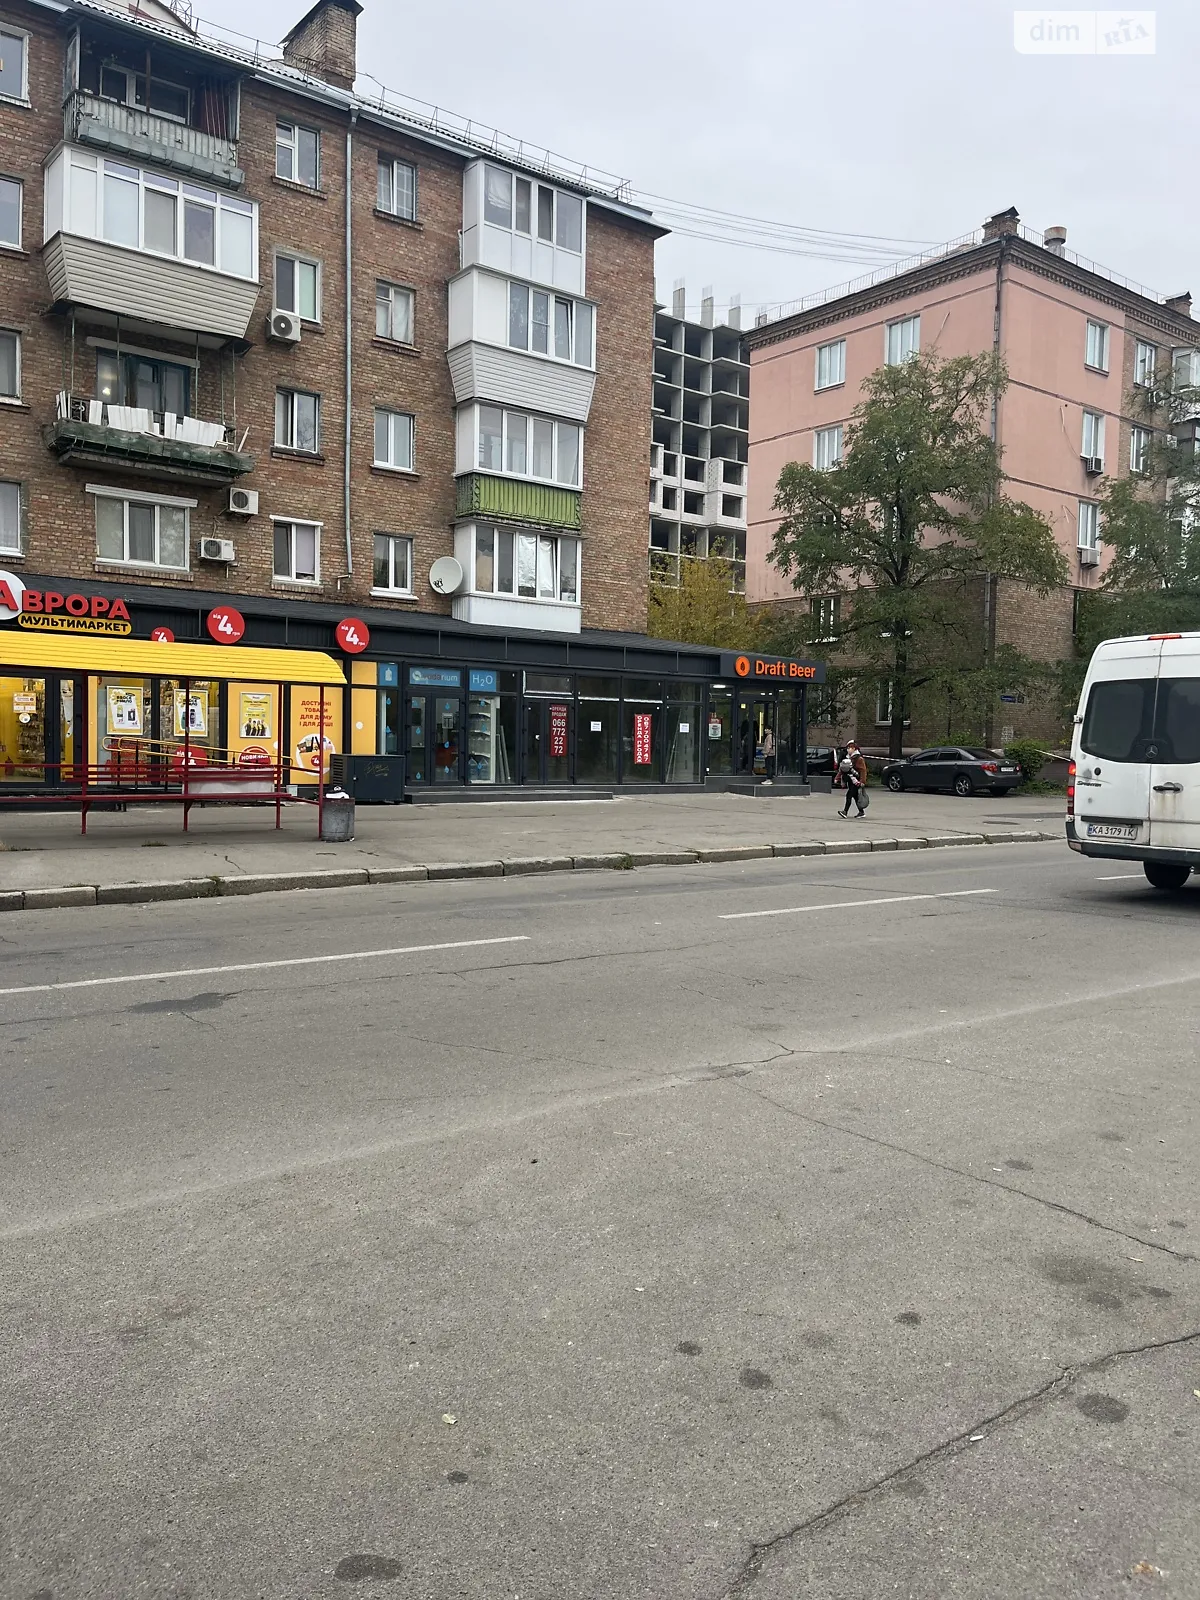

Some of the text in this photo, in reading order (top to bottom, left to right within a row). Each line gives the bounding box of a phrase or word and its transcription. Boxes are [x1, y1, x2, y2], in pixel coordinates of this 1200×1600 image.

[20, 615, 129, 632] МУЛЬТИМАРКЕТ
[218, 615, 233, 635] 4
[346, 626, 359, 645] 4
[755, 660, 816, 679] Draft Beer
[552, 718, 566, 727] 066
[552, 727, 566, 736] 772
[554, 736, 564, 745] 22
[554, 745, 564, 754] 72
[1092, 825, 1135, 837] KA 3179 IK
